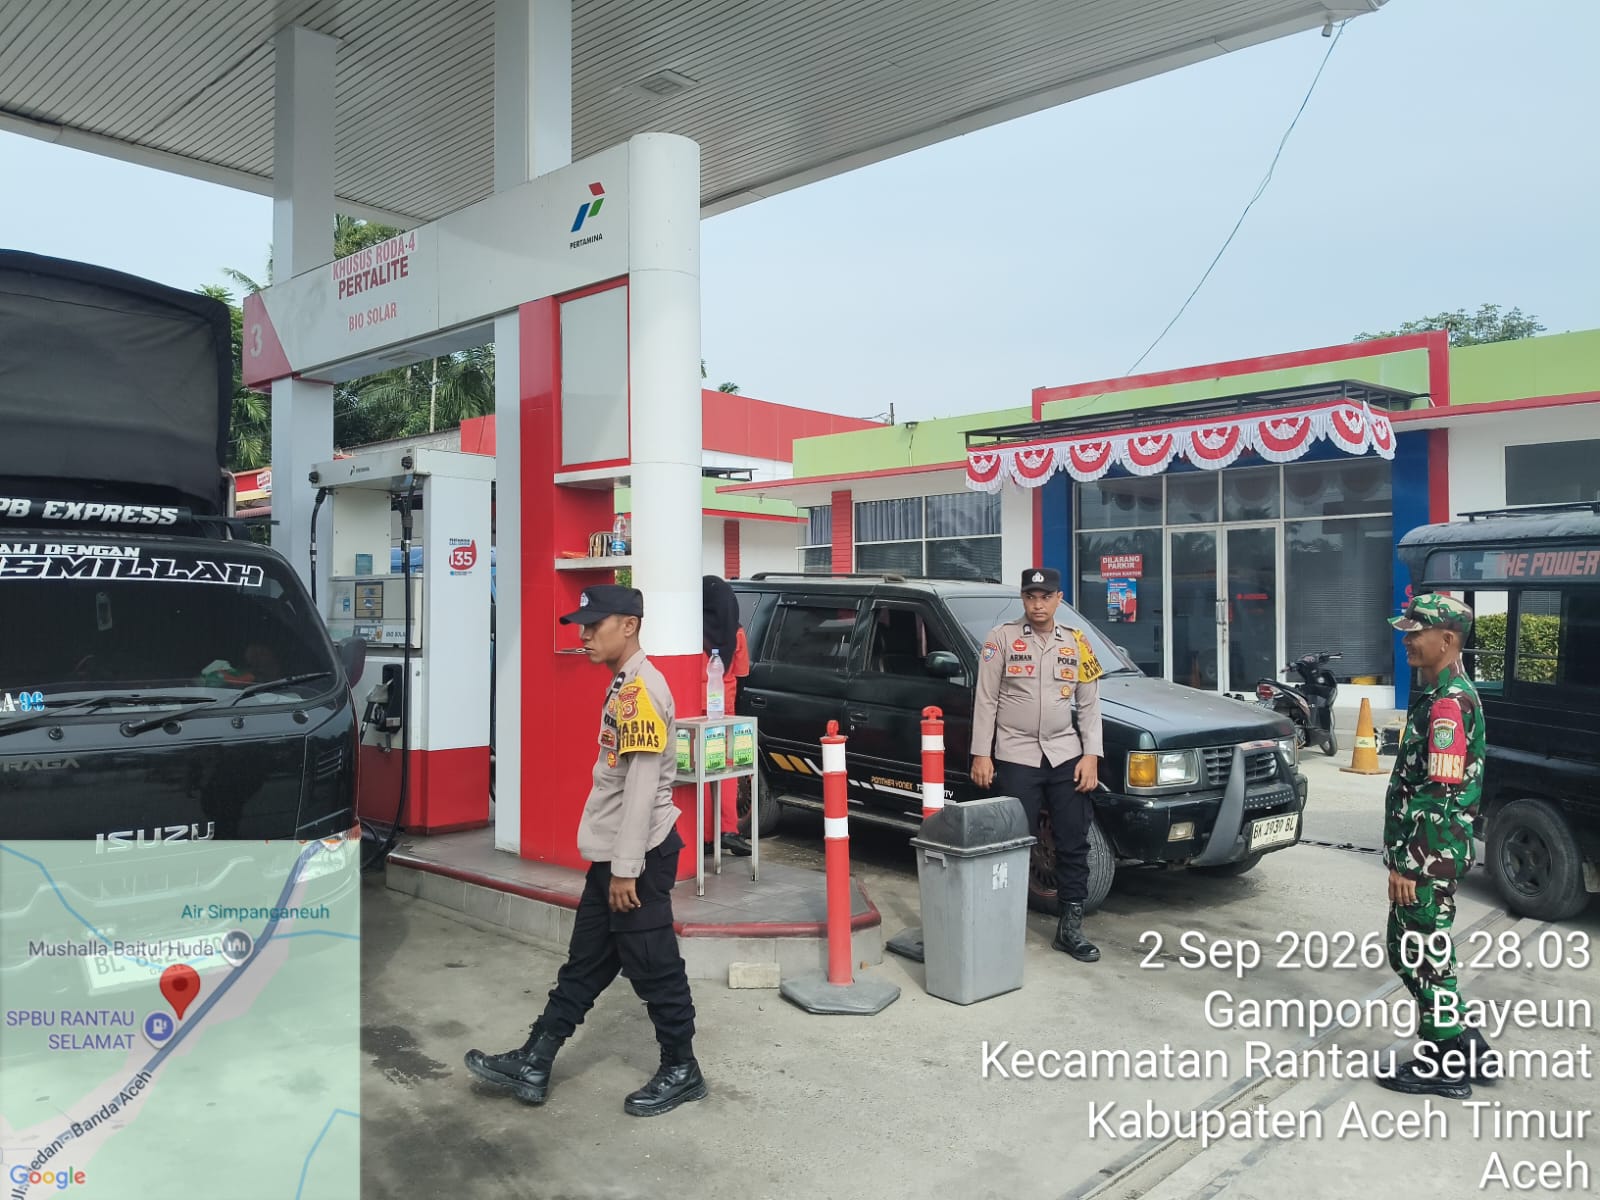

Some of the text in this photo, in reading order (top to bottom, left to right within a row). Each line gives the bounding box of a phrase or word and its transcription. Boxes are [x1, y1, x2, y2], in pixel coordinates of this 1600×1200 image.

[569, 233, 603, 250] PERTAMINA
[333, 250, 373, 281] KHUSUS
[338, 256, 409, 300] PERTALITE
[348, 302, 397, 332] BIO SOLAR
[249, 323, 263, 358] 3
[42, 501, 179, 525] EXPRESS
[44, 543, 140, 557] DENGAN
[450, 551, 473, 566] 135
[1102, 555, 1140, 563] DILARANG
[0, 555, 265, 587] SMILLAH
[1496, 550, 1600, 576] THE POWER
[1009, 654, 1033, 662] ARMAN
[0, 757, 80, 773] RAGA
[96, 822, 216, 855] ISUZU
